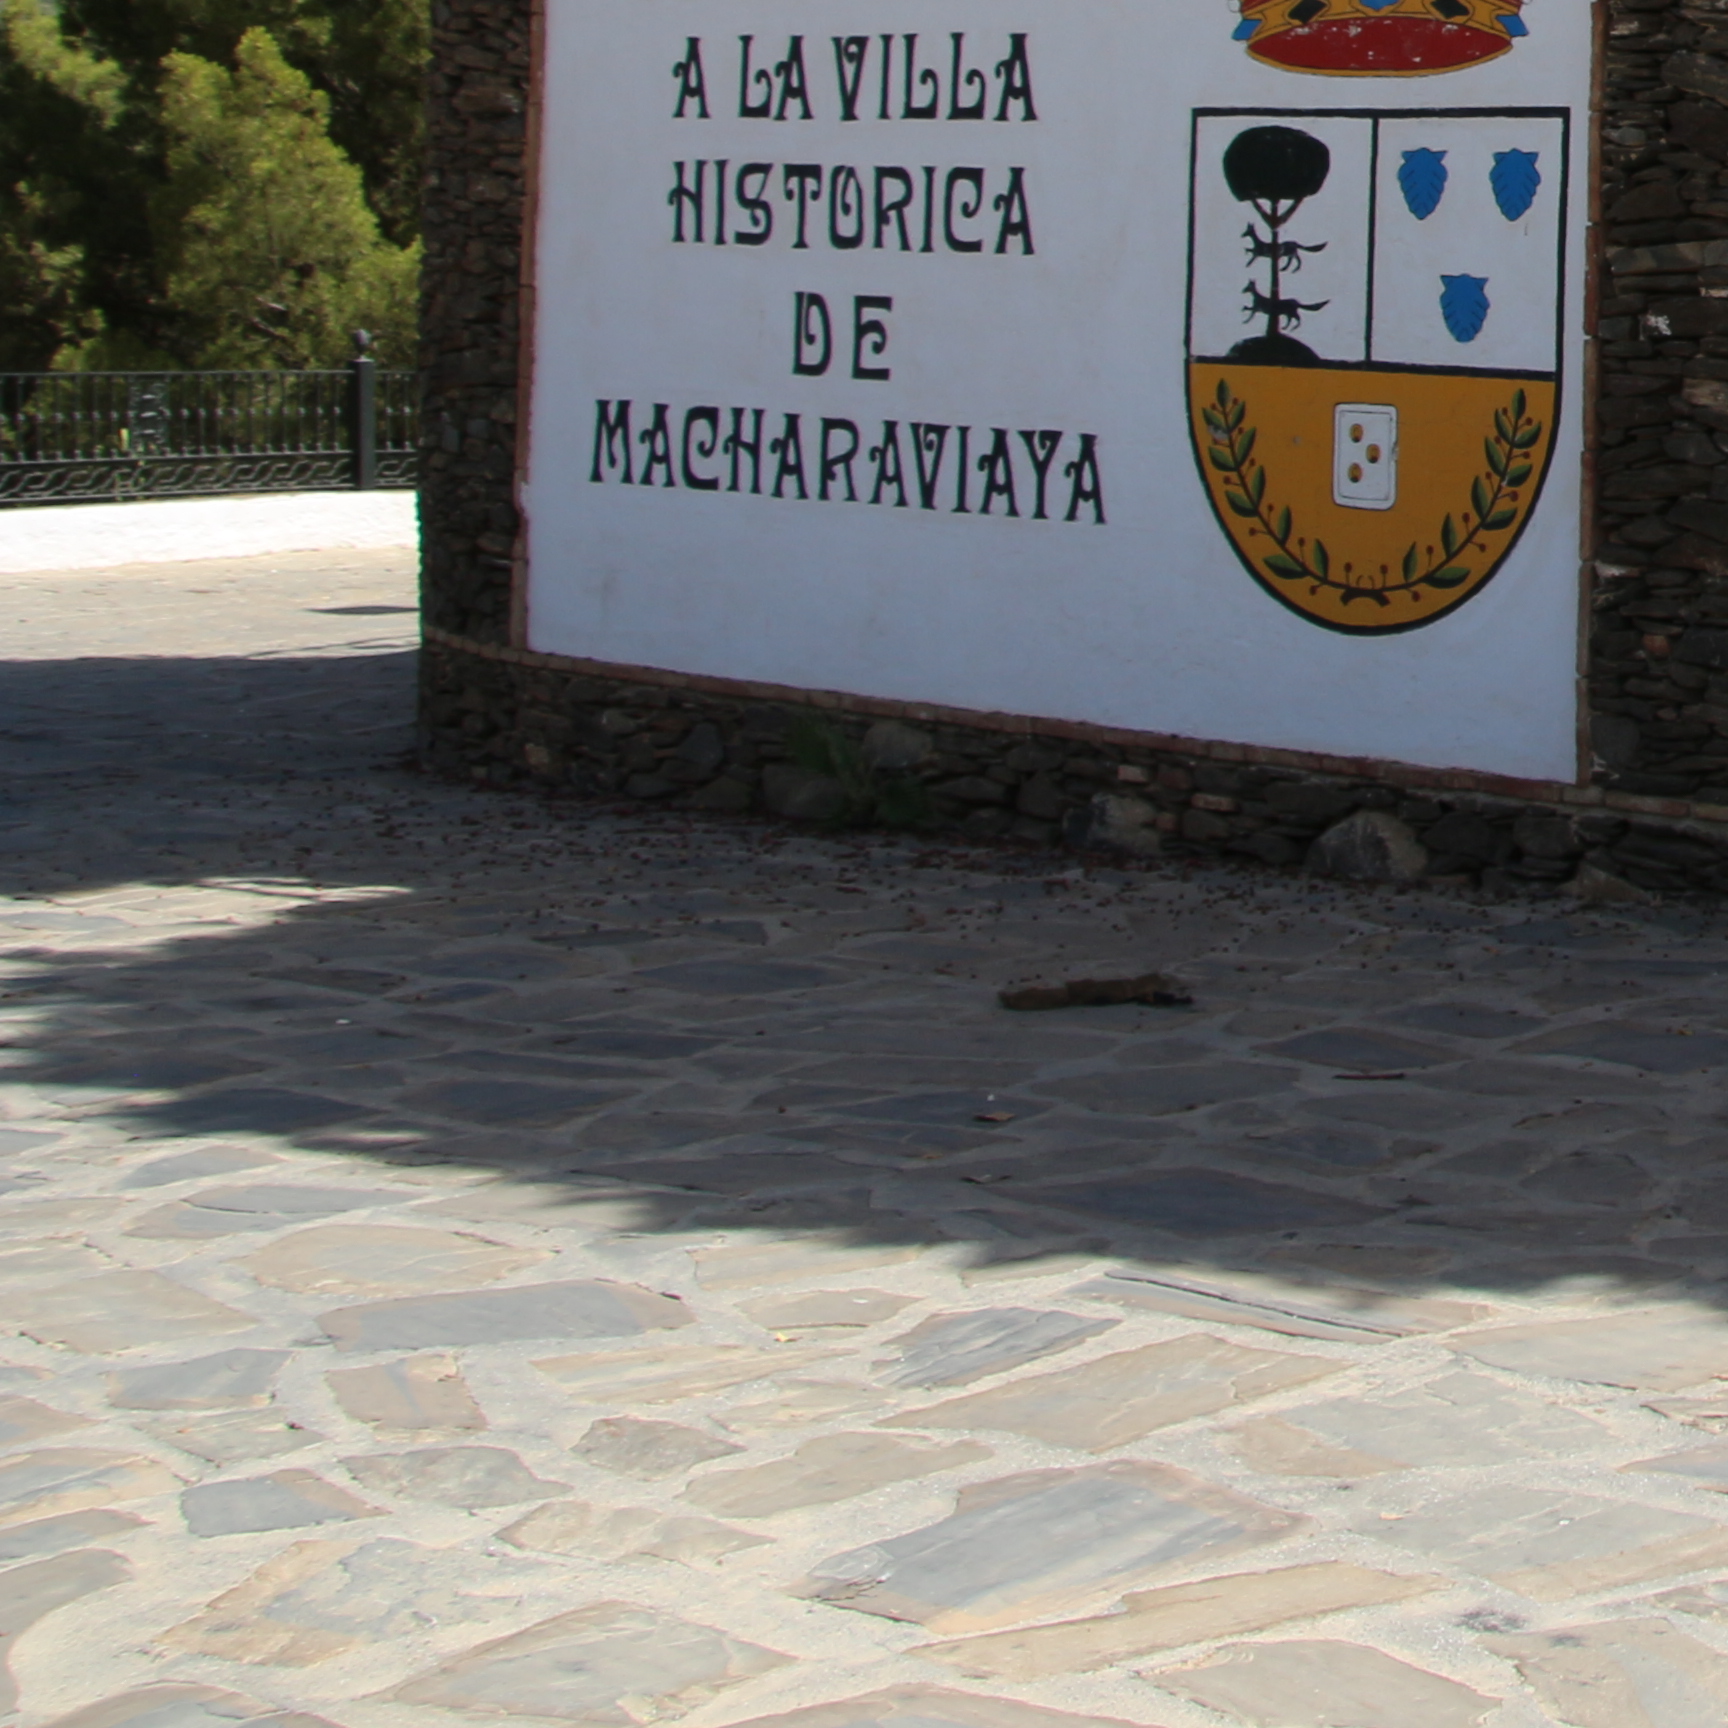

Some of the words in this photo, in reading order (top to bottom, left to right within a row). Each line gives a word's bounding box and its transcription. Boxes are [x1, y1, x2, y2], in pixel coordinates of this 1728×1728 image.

[671, 35, 712, 120] A
[737, 33, 815, 123] LA
[830, 31, 1039, 122] VILLA
[666, 158, 1036, 257] HISTORICA
[791, 290, 894, 382] DE
[588, 397, 1108, 526] MACHARAVIAYA
